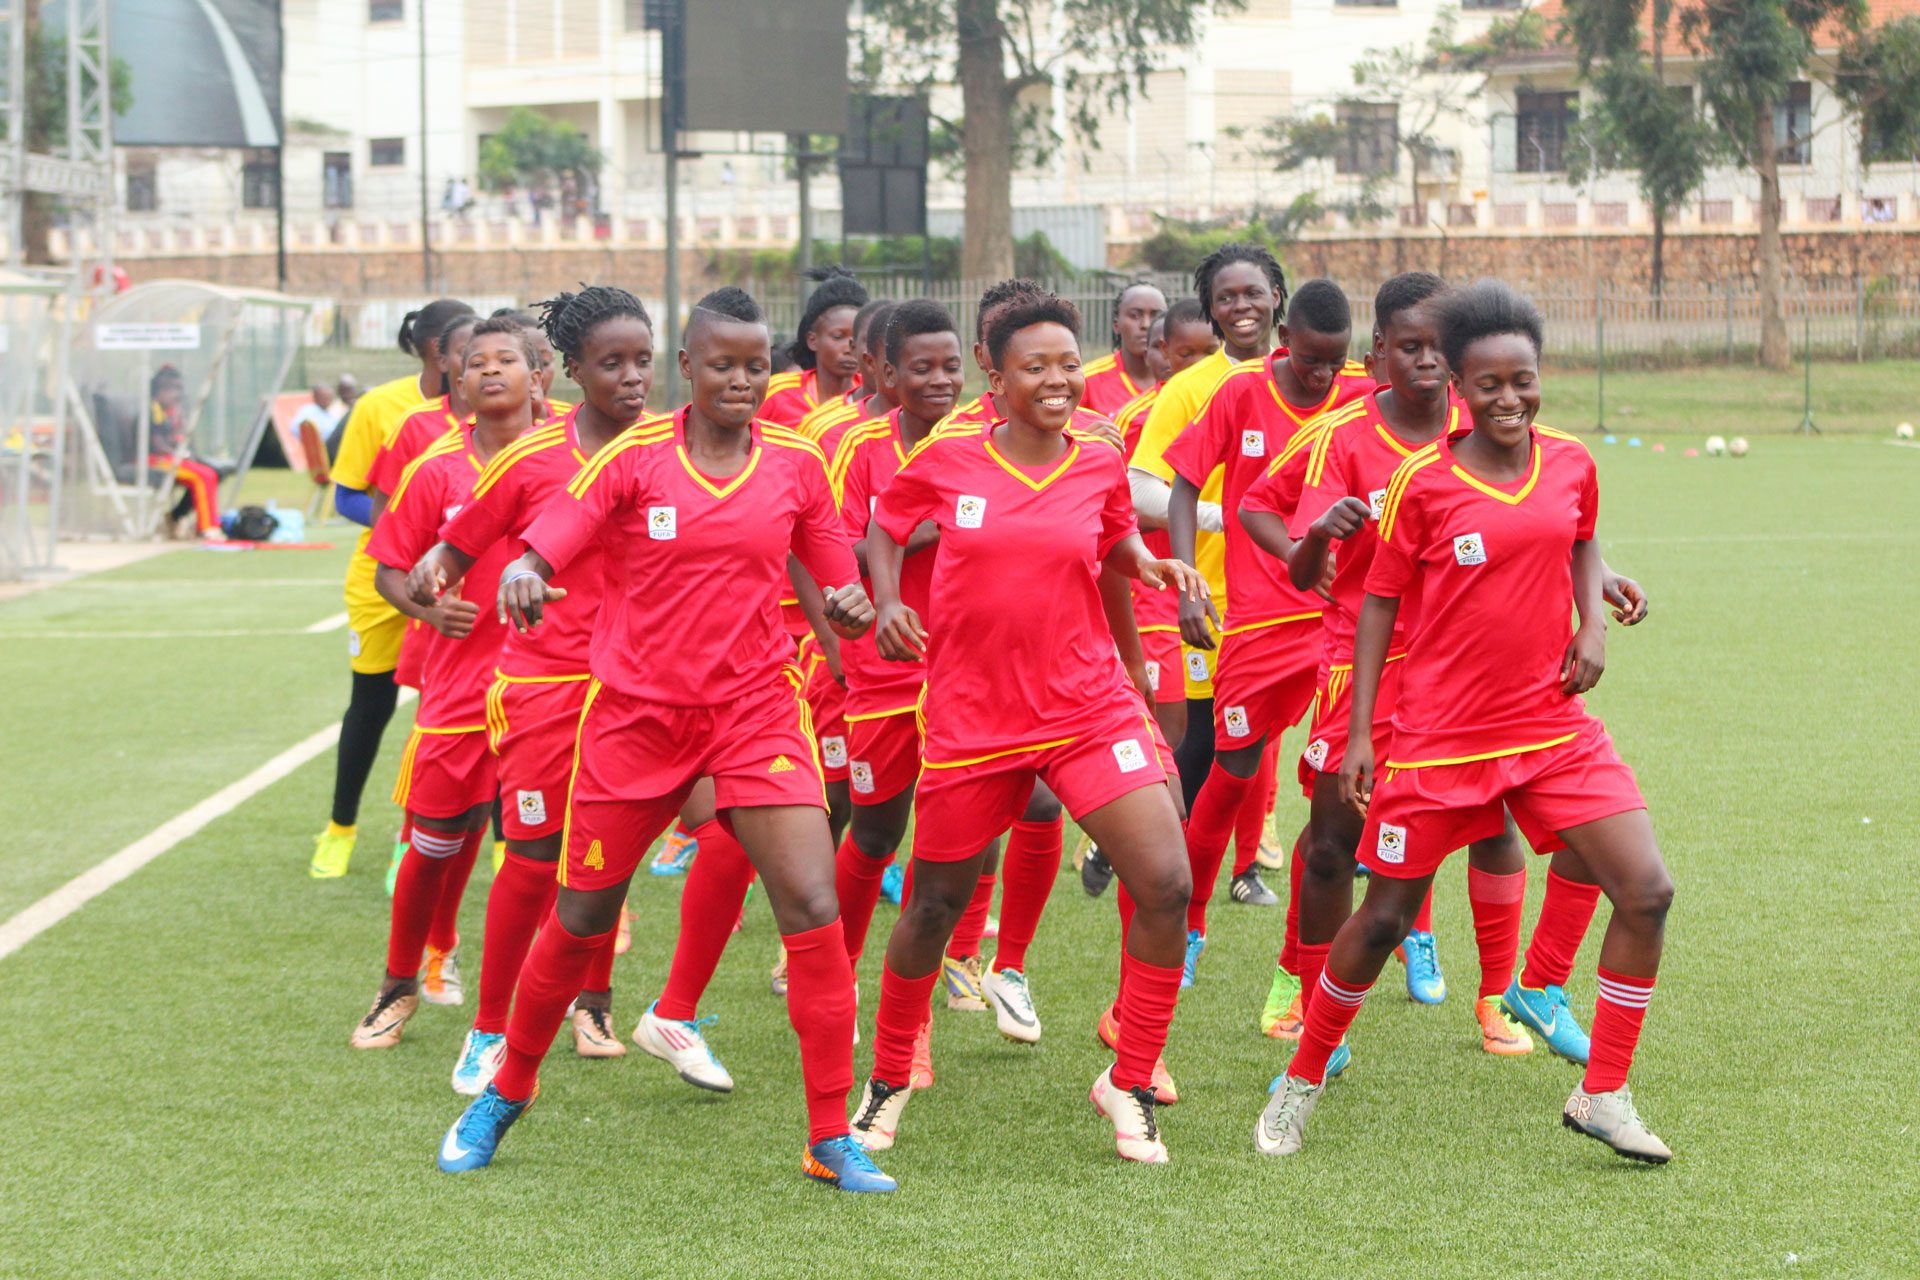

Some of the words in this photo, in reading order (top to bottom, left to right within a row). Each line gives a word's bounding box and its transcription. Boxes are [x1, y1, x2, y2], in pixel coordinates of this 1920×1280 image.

[768, 764, 796, 774] adidas
[1125, 761, 1142, 770] FUFA
[583, 839, 605, 871] 4
[1380, 851, 1399, 860] FUFA
[1565, 1095, 1603, 1121] CR7
